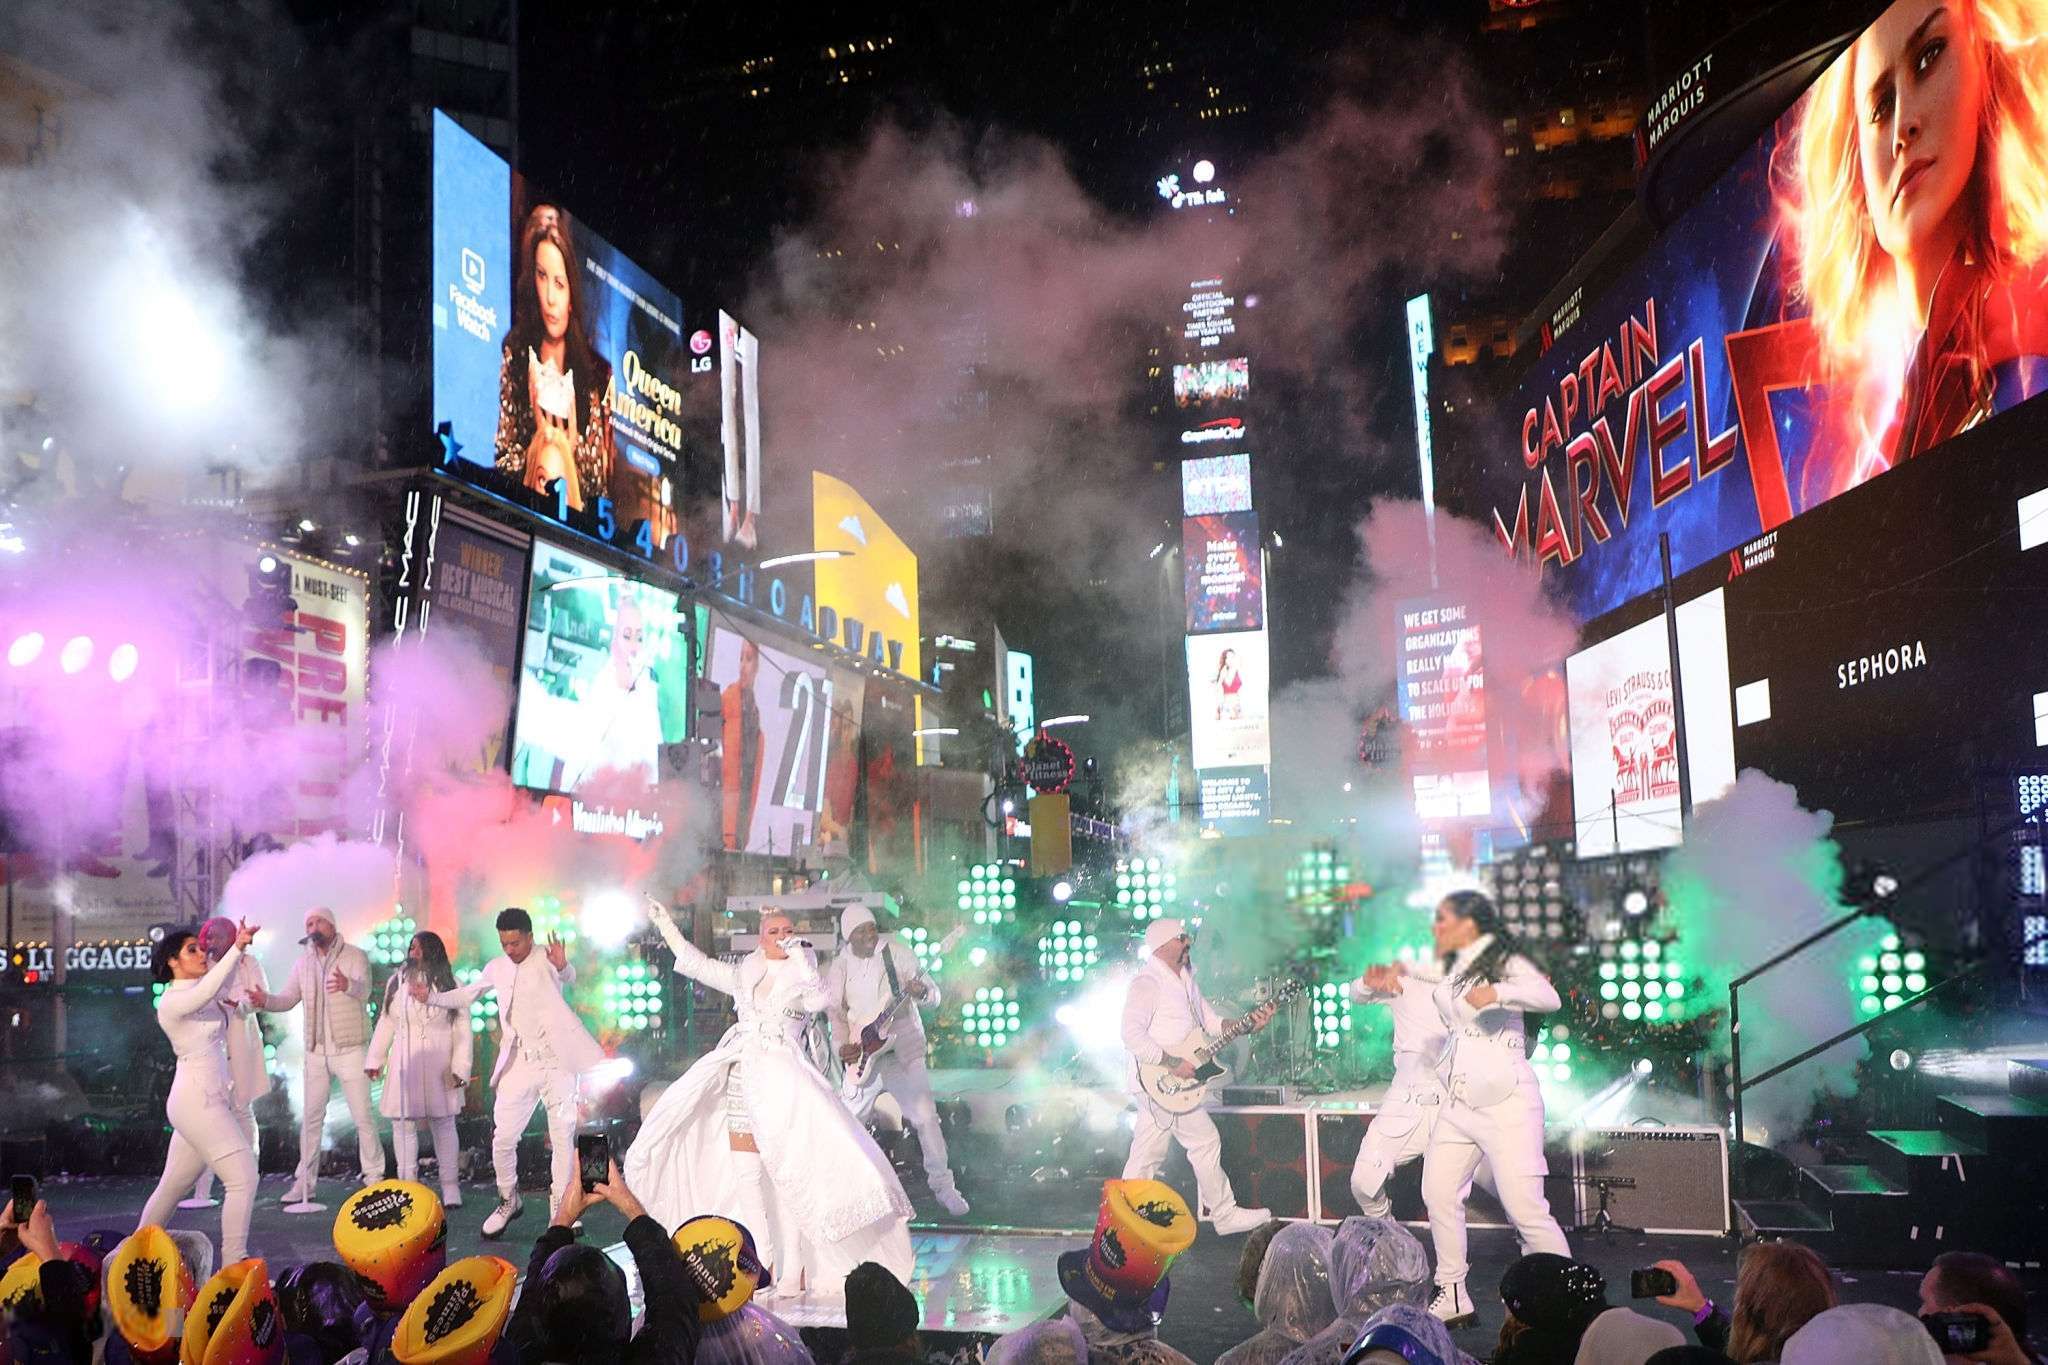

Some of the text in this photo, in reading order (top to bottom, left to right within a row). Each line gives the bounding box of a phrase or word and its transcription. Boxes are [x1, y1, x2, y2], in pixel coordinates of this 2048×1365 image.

[1647, 53, 1713, 128] MARRIOTT
[1649, 85, 1705, 150] MARQUIS
[1552, 286, 1582, 326] MARRIOTT
[1553, 305, 1580, 341] MARQUIS
[622, 350, 682, 416] Queen
[691, 356, 712, 373] LG
[1521, 296, 1659, 470] CAPTAIN
[600, 374, 682, 450] America
[1493, 336, 1739, 582] MARVEL
[553, 477, 689, 574] 1540
[1743, 530, 1778, 558] MARRIOTT
[1744, 546, 1775, 571] MARQUIS
[440, 562, 469, 597] BEST
[469, 572, 515, 613] MUSICAL
[1403, 604, 1467, 630] WE GET SOME
[1406, 654, 1441, 676] REALLY
[1837, 640, 1927, 689] SEPHORA
[1408, 682, 1421, 698] TO
[1605, 688, 1622, 709] LEVI
[1623, 671, 1656, 701] STRAUSS
[1408, 704, 1428, 721] THE
[783, 671, 833, 813] 21
[1024, 761, 1061, 775] planet
[573, 800, 625, 835] YouTube
[686, 1251, 720, 1289] planet
